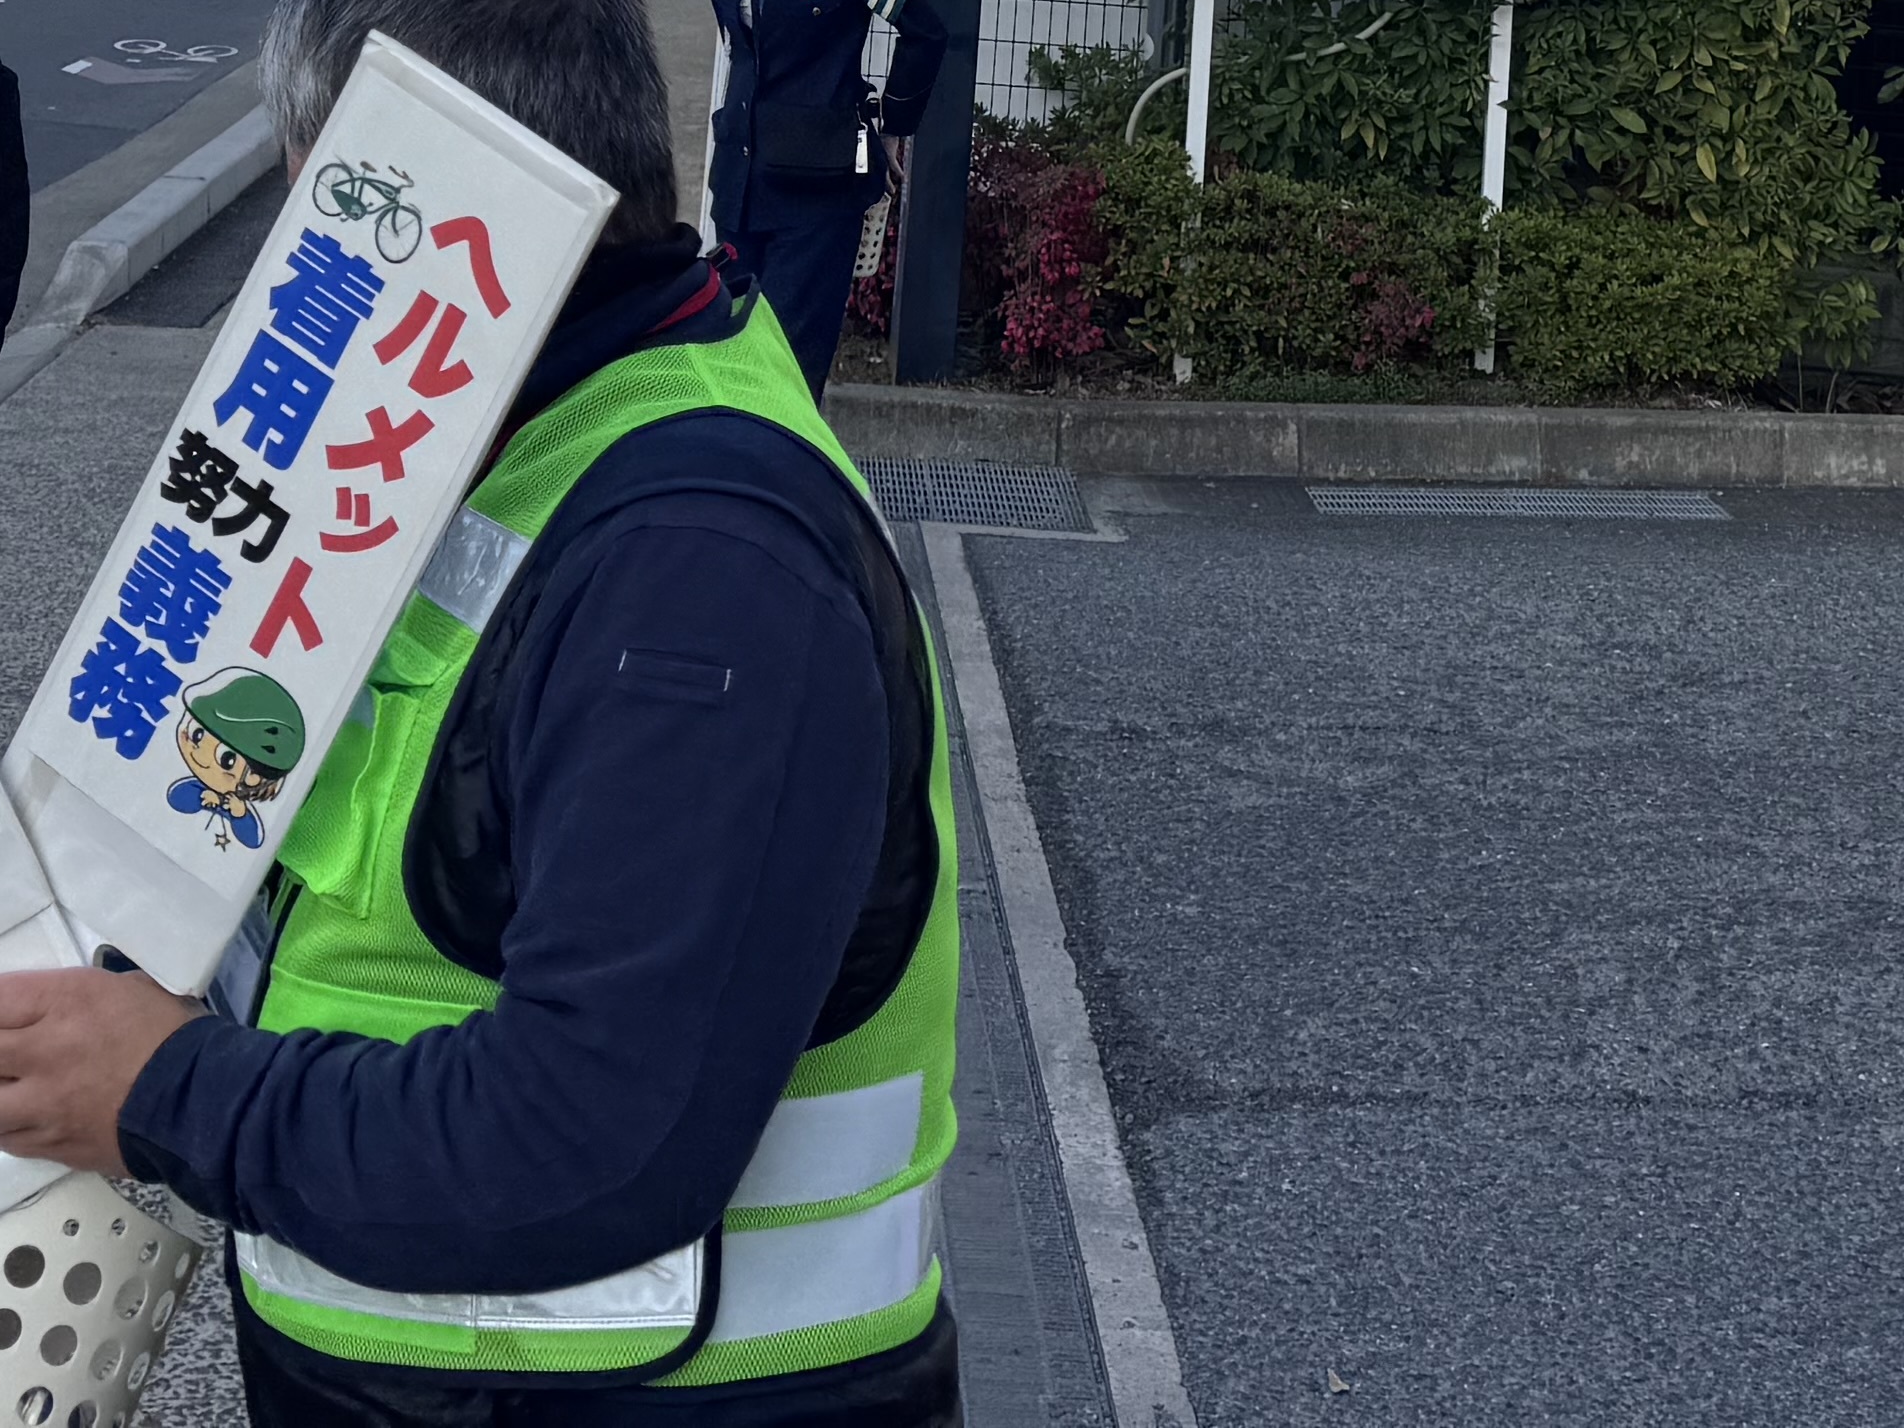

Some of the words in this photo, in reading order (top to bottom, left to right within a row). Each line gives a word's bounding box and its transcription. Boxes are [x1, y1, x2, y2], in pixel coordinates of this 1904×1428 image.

[248, 214, 511, 658] ヘルメット
